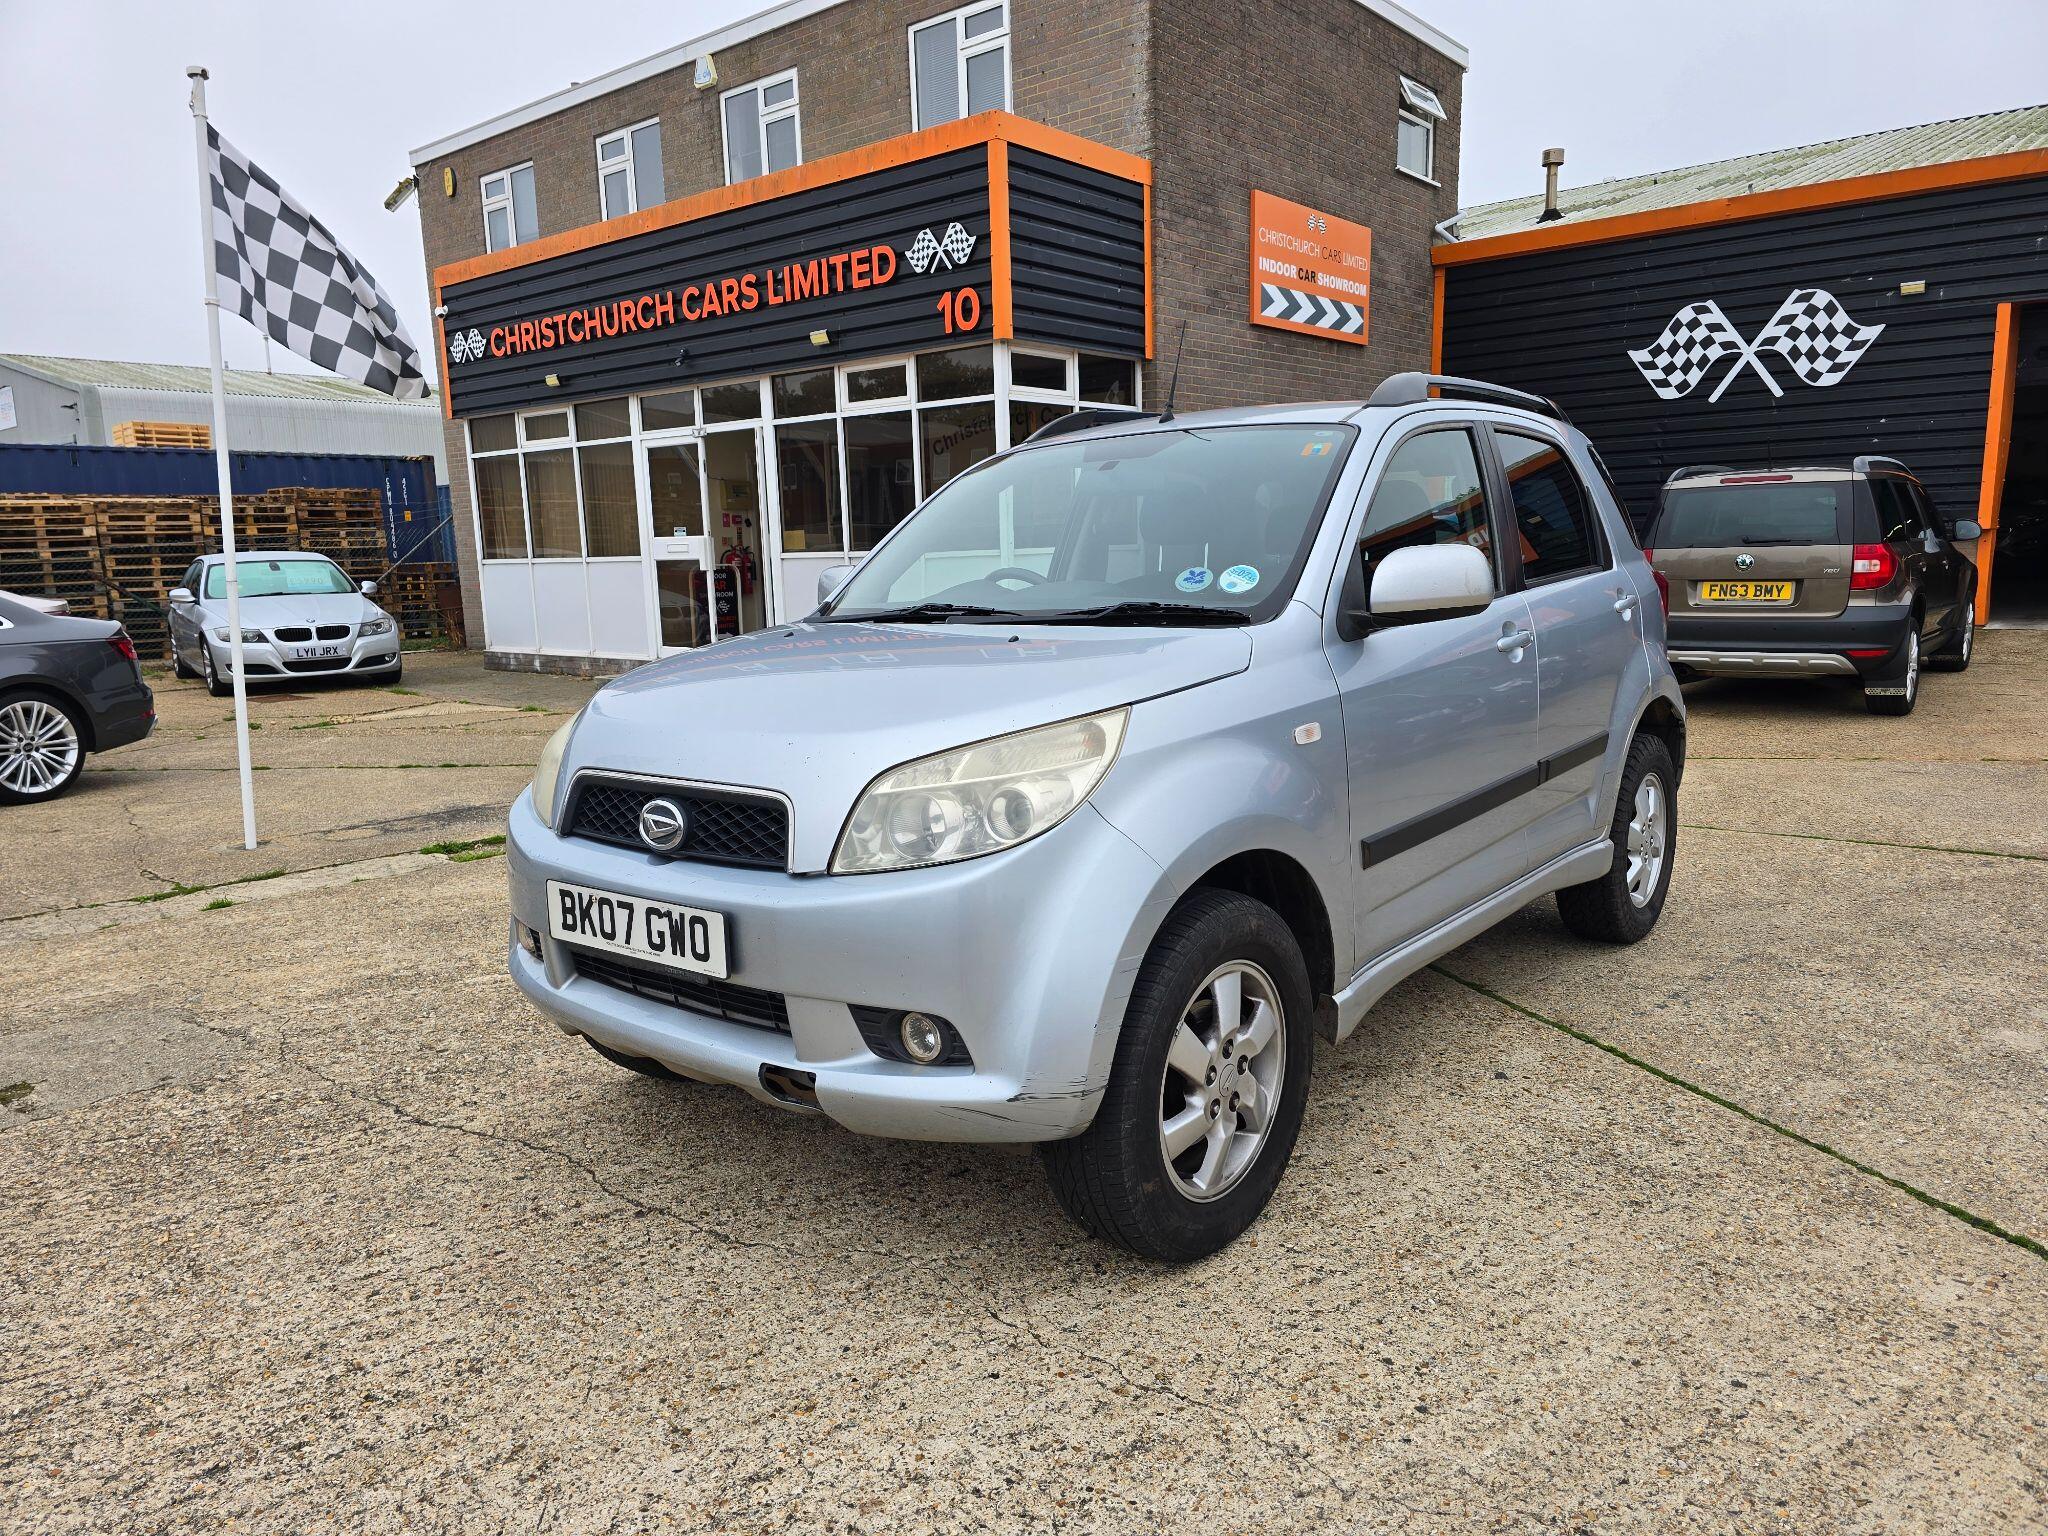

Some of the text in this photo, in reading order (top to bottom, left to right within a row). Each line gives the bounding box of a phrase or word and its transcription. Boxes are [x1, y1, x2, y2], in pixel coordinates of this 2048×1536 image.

[1259, 227, 1367, 271] CHRISTCHURCH CARS LIMITED
[1259, 256, 1367, 297] INDOOR CAR SHOWROOM
[490, 245, 896, 357] CHRISTCHURCH CARS LIMITED
[937, 287, 980, 334] 10
[1708, 584, 1785, 598] FN63 BMY
[296, 646, 339, 658] LY11 JRX
[558, 888, 711, 963] BK07 GWO
